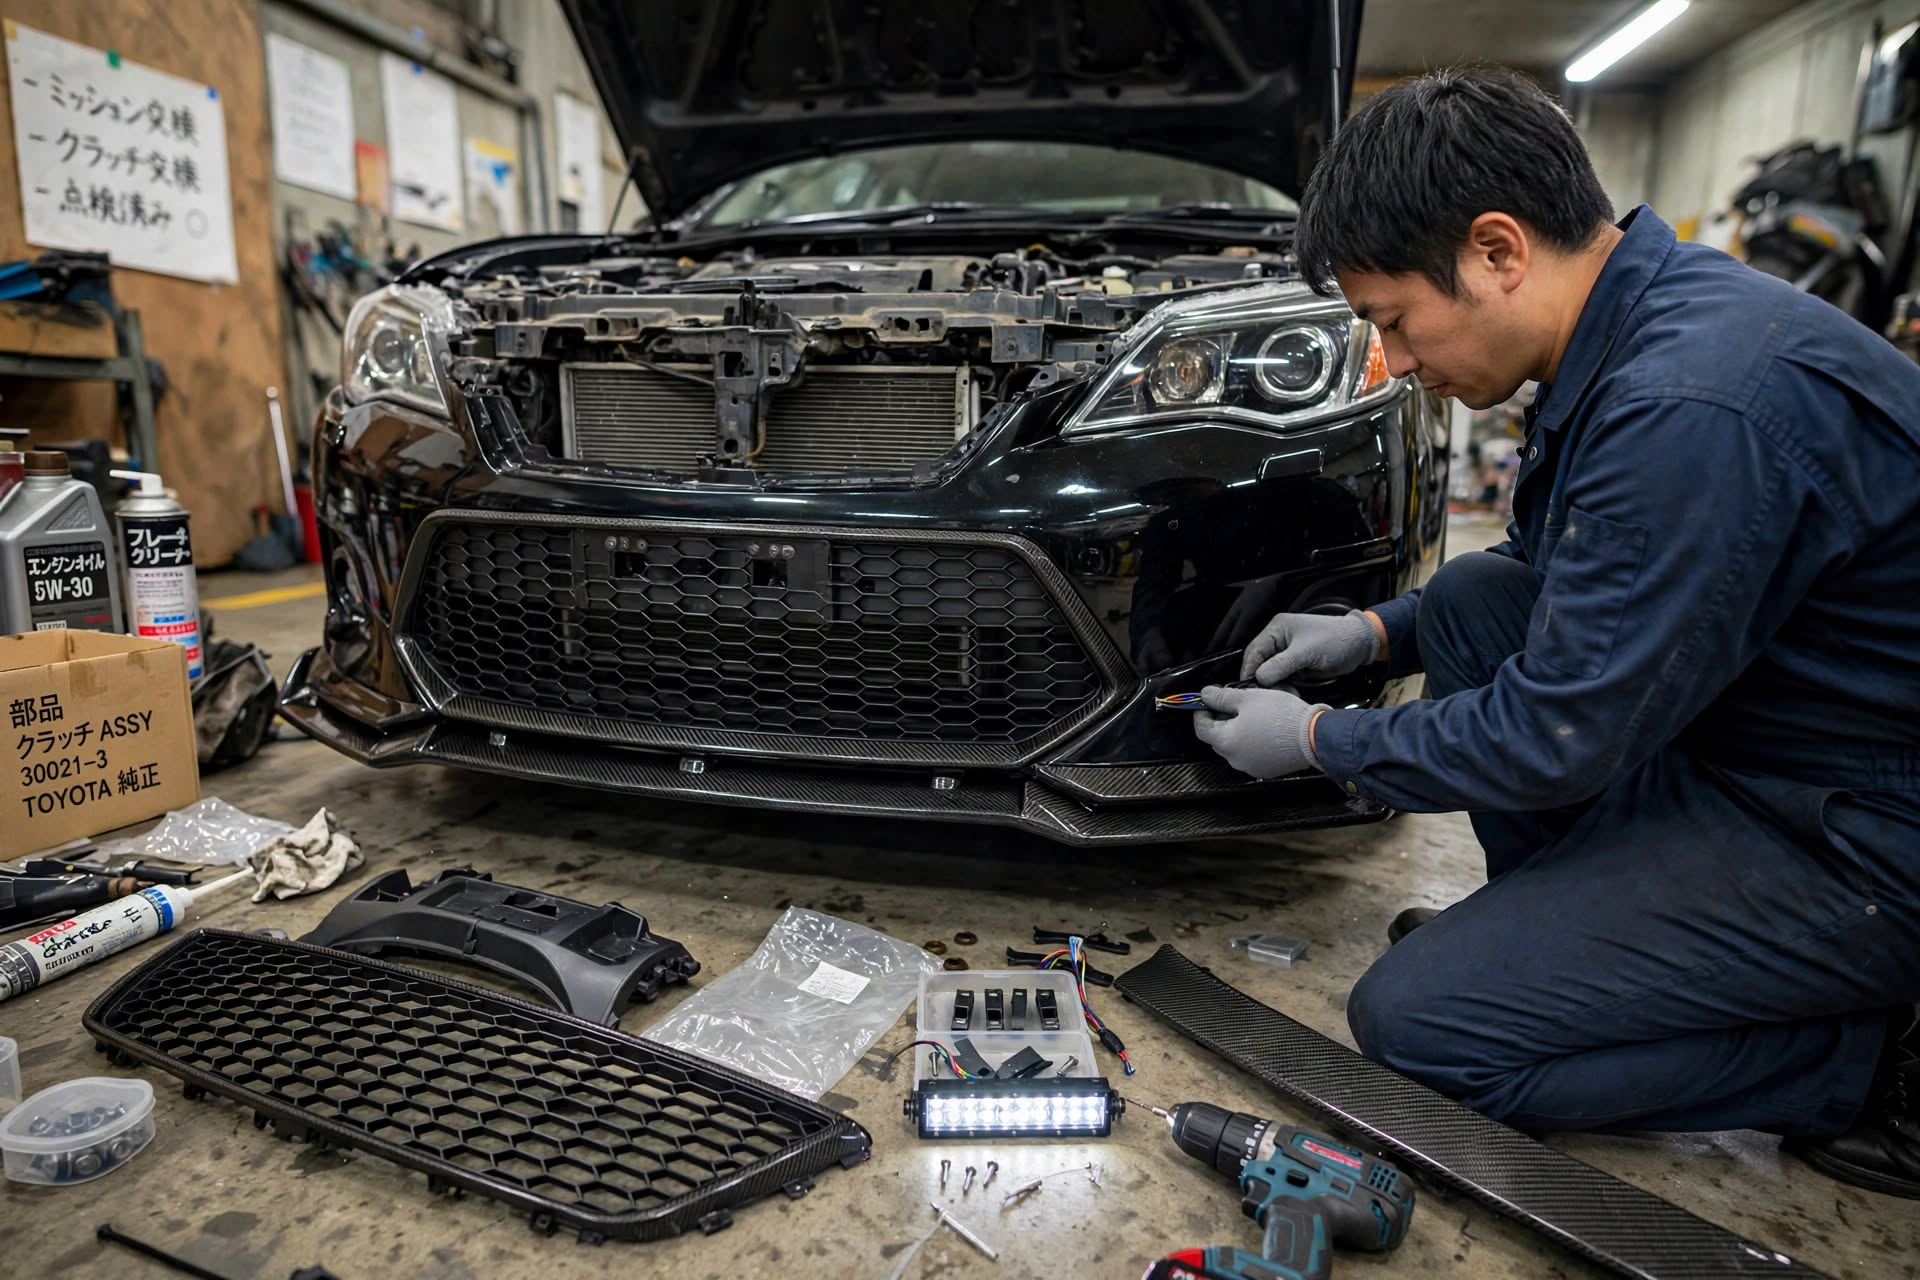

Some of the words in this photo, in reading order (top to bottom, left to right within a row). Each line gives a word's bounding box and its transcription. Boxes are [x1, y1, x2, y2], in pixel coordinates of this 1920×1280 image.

[34, 576, 93, 601] 5W-30
[8, 693, 64, 729] 部品
[16, 721, 94, 760] クラッチ
[99, 709, 153, 742] ASSY
[20, 749, 108, 787] 30021-3
[22, 779, 112, 818] TOYOTA
[117, 762, 161, 796] 純正
